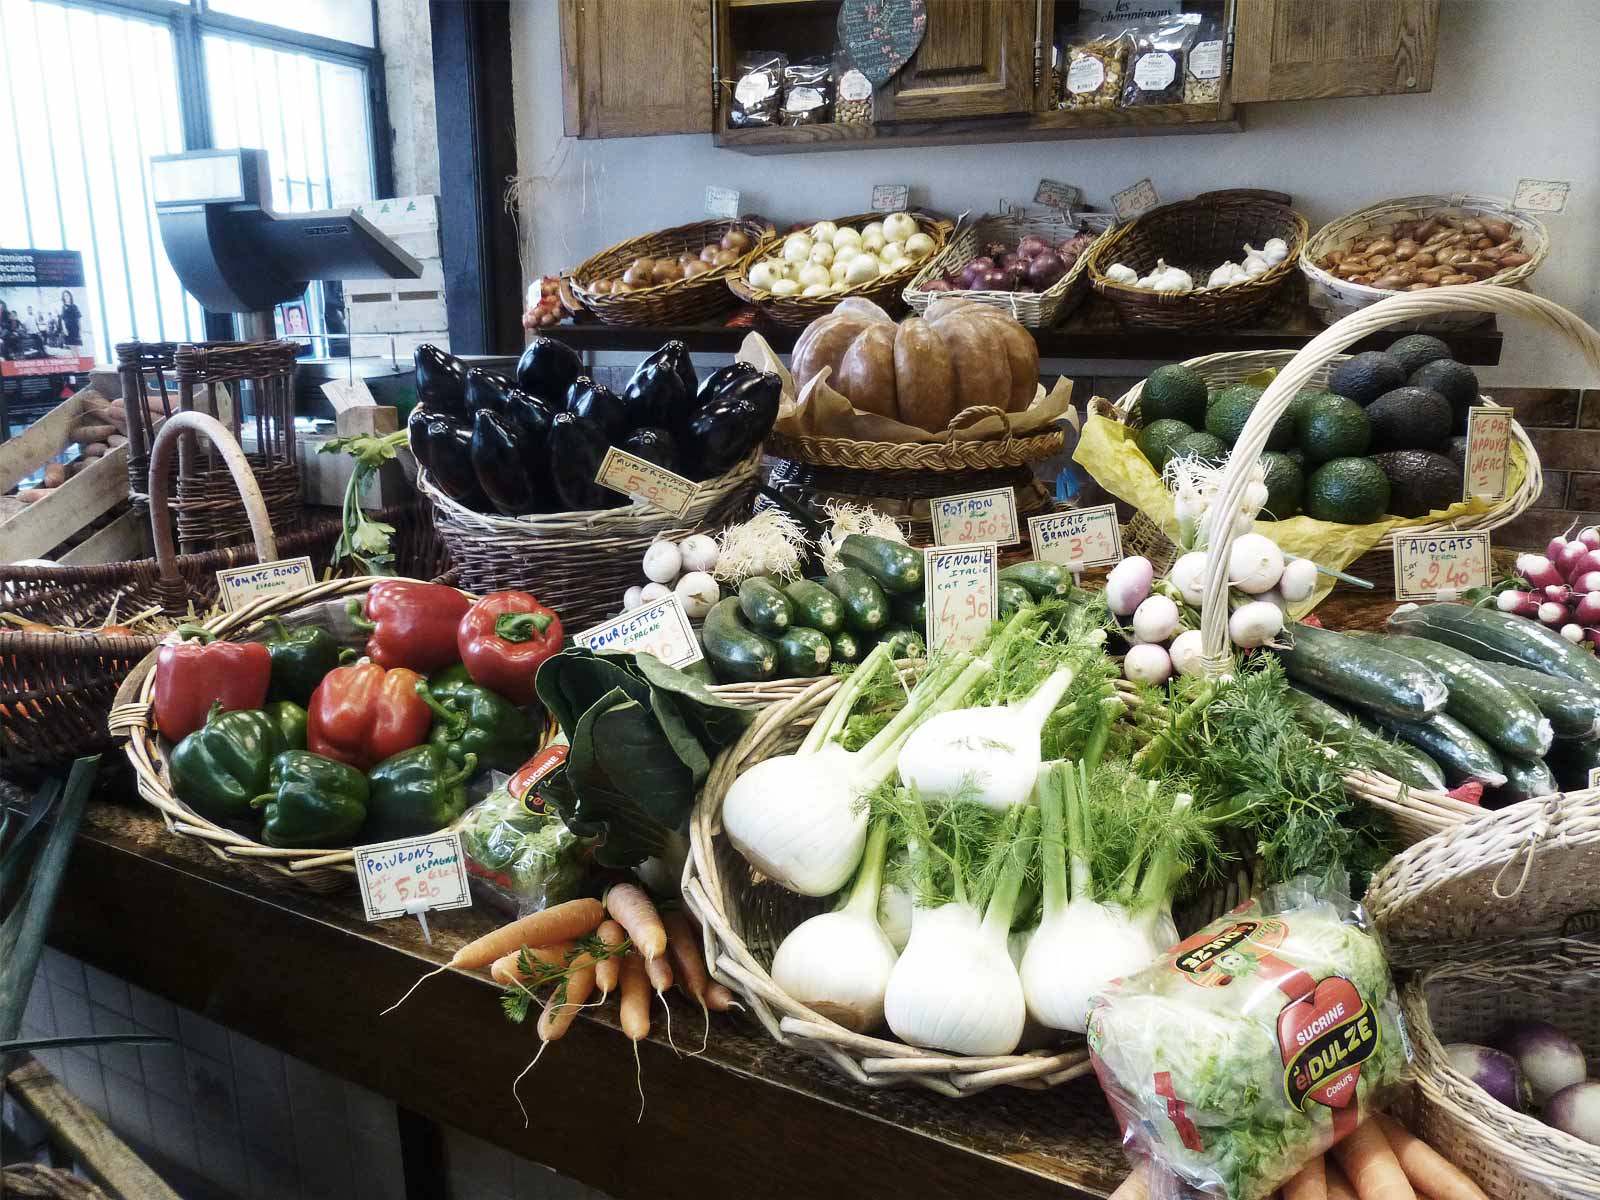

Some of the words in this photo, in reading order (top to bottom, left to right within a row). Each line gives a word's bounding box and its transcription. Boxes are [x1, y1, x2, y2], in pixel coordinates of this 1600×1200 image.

[1474, 419, 1489, 433] NE
[1042, 523, 1088, 542] BRANCHE
[1410, 538, 1473, 555] AVOCATS
[226, 571, 268, 587] TOMATE
[949, 567, 989, 577] ITALIE
[590, 607, 665, 650] COURGETTES
[623, 622, 661, 646] ESPAGNE
[522, 755, 560, 788] SUCRINE
[1296, 1002, 1345, 1046] SUCRINE
[1326, 1073, 1353, 1098] Coeurs
